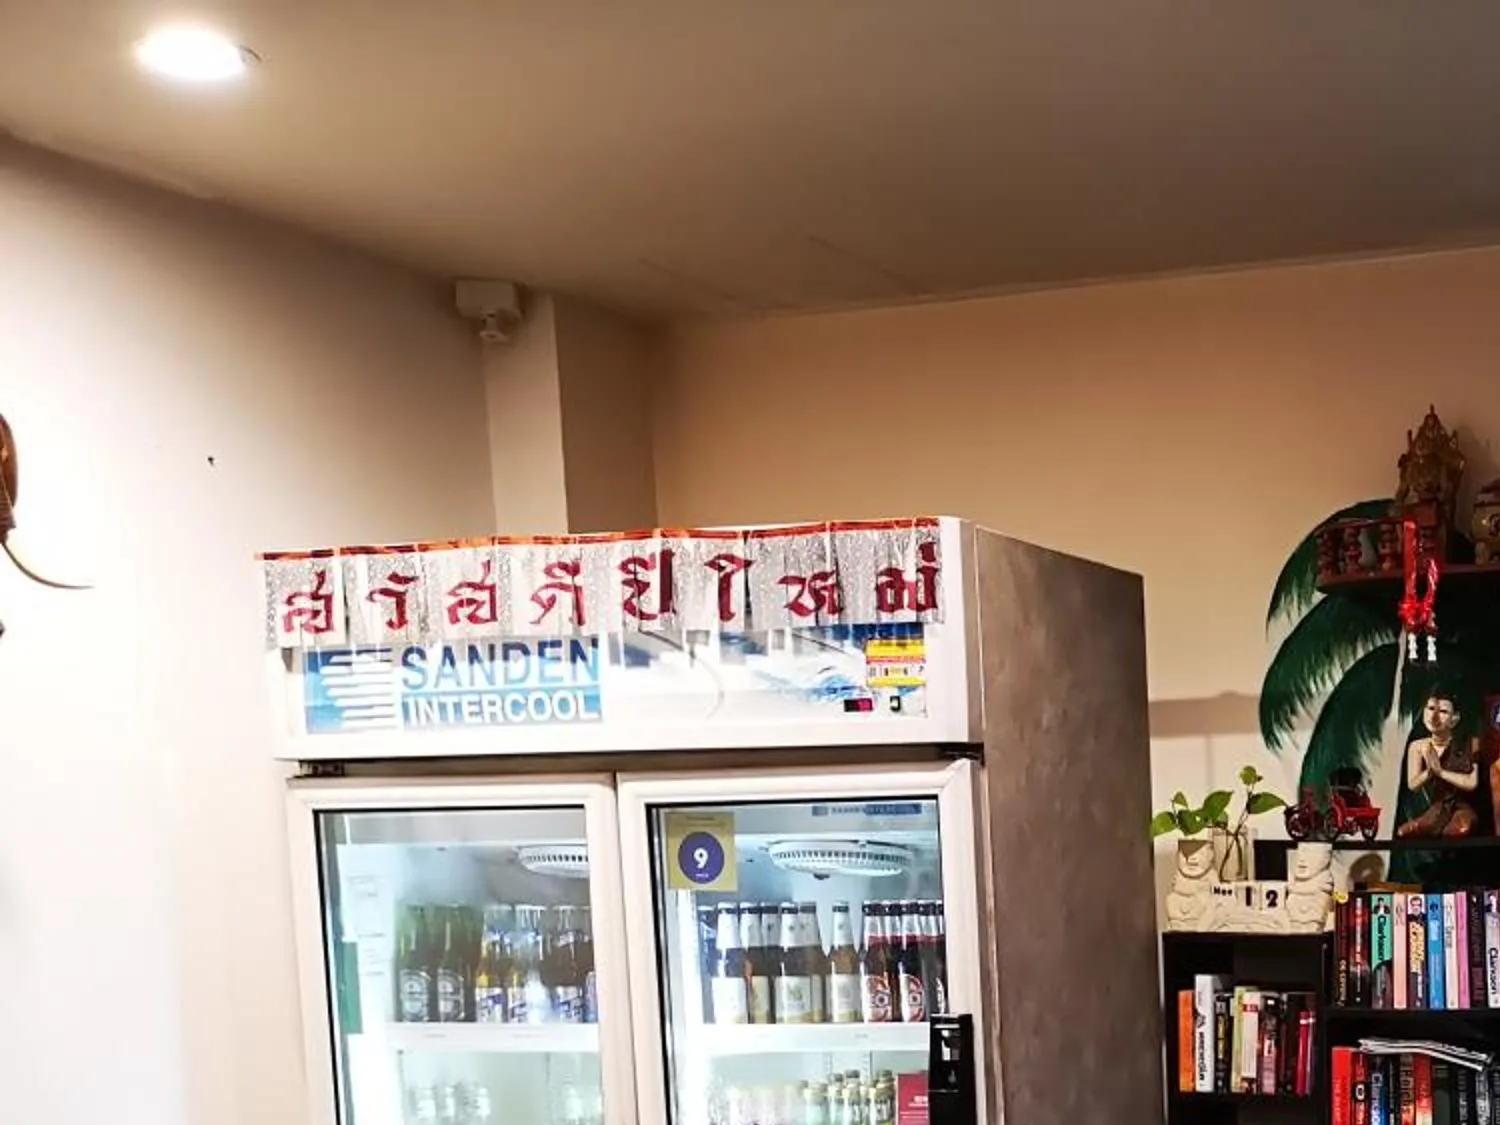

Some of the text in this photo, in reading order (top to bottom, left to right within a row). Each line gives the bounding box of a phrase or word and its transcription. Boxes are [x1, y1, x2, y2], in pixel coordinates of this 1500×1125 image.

[401, 639, 600, 690] SANDEN
[402, 690, 601, 727] INTERCOOL
[693, 847, 709, 869] 9
